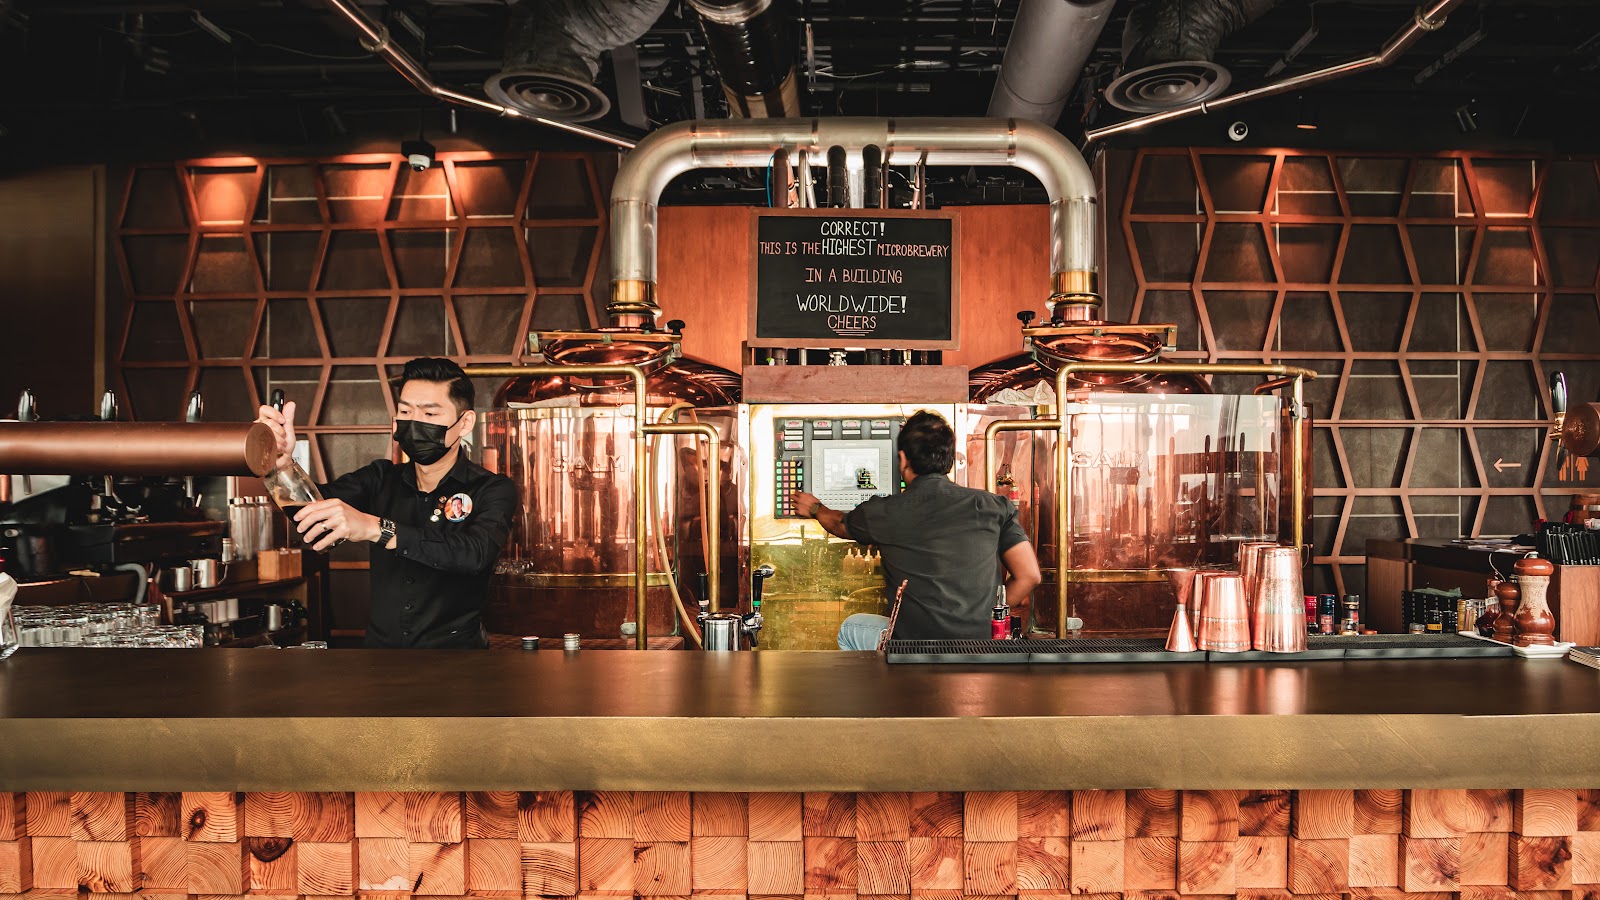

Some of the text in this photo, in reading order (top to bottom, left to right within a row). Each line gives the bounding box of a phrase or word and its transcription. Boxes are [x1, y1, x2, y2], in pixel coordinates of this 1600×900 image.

[821, 221, 885, 236] CORRECT!
[760, 238, 949, 257] THIS IS THE HIGHEST MICROBREWERY
[805, 267, 903, 284] IN A BUILDING
[828, 315, 877, 329] CHEERS
